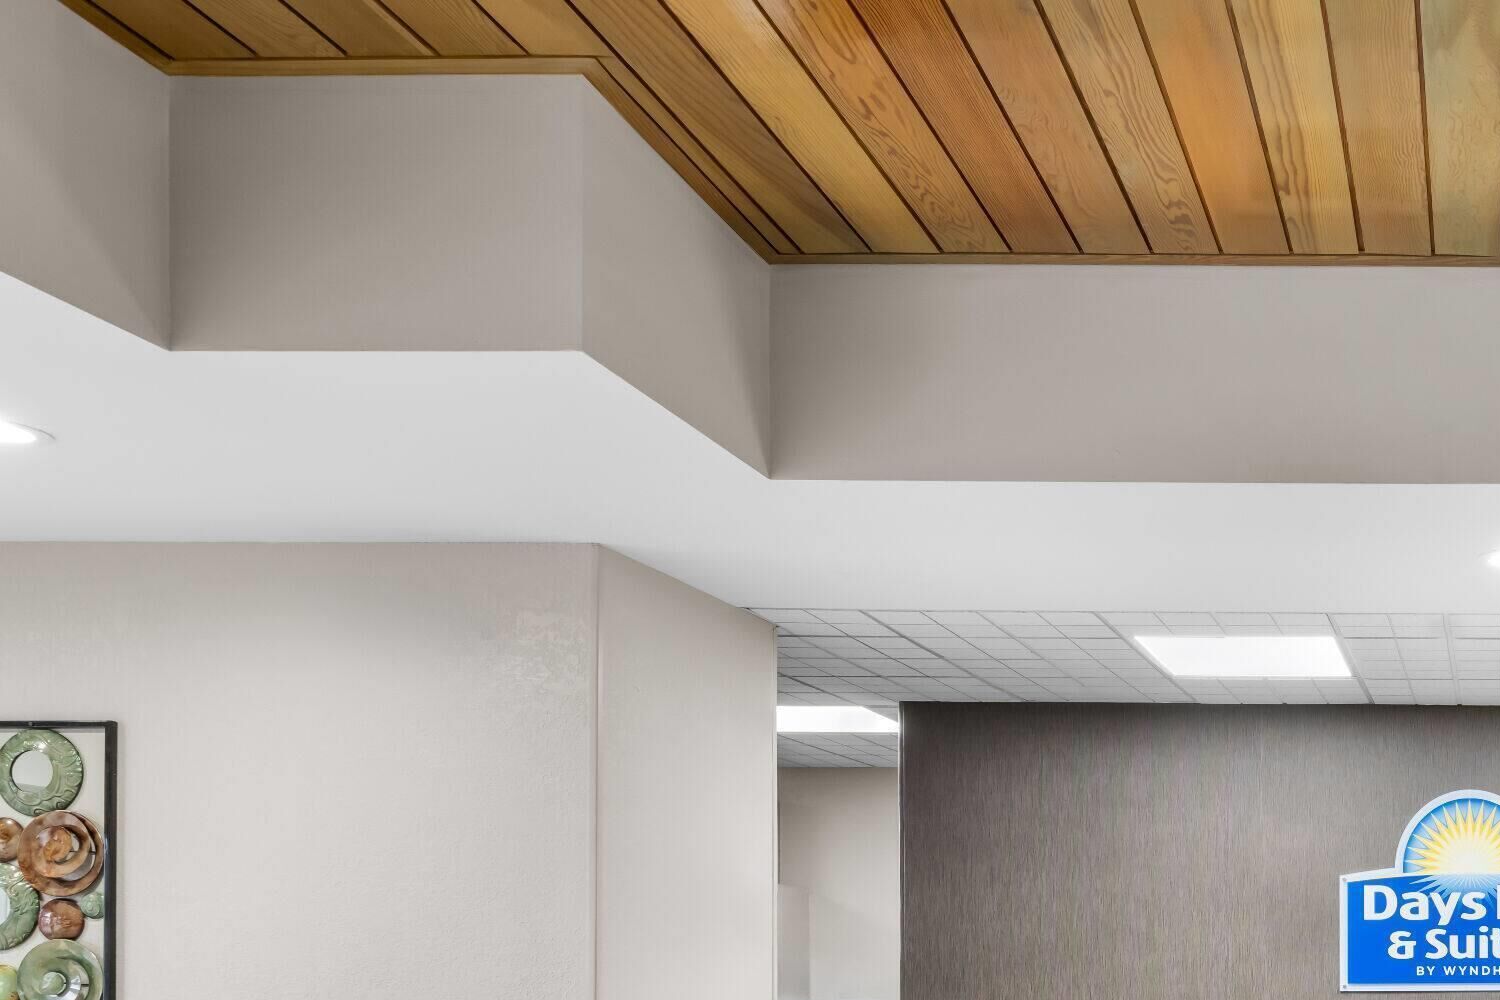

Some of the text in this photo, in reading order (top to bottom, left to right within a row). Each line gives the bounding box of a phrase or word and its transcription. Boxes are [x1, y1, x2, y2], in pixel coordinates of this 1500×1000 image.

[1363, 885, 1486, 926] Days
[1387, 931, 1417, 960] &
[1416, 965, 1435, 976] BY
